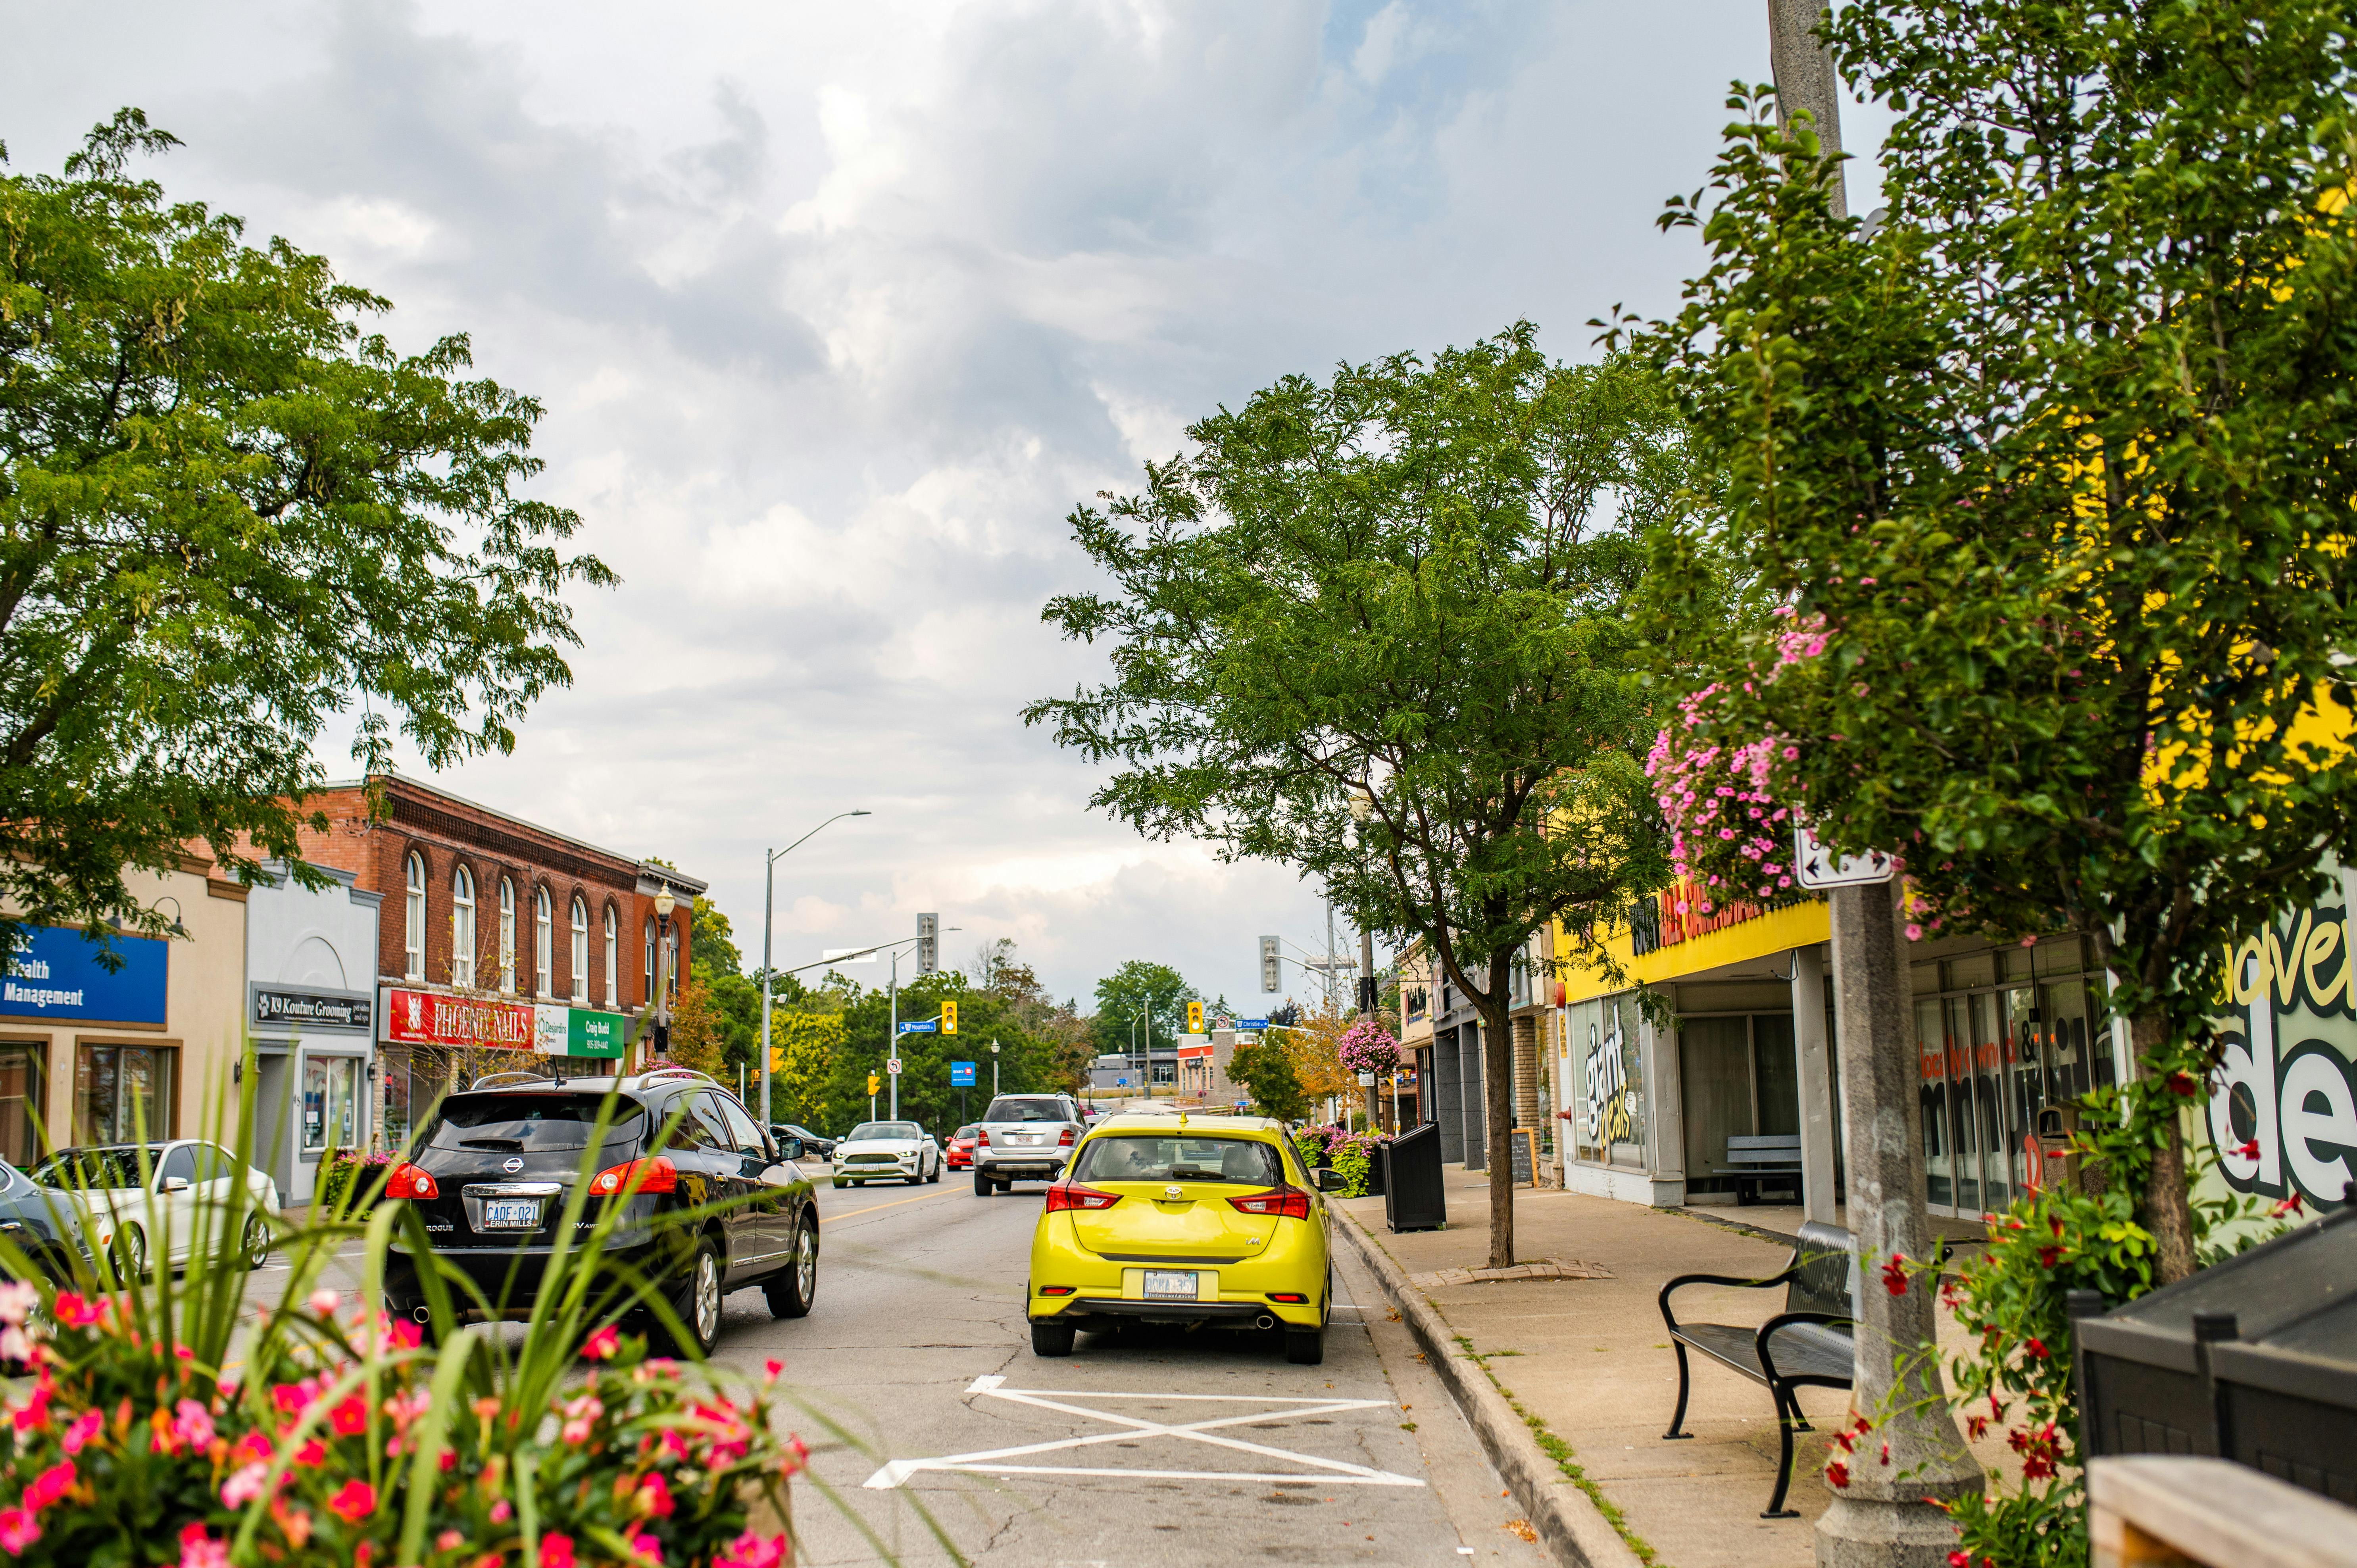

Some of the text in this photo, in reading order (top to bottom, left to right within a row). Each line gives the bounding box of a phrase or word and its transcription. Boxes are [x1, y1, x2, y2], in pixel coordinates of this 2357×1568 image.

[1660, 884, 1684, 947] ALL
[4, 982, 83, 1008] Management
[271, 997, 352, 1023] K9 Kouture Grooming
[434, 1002, 528, 1042] PHOENIX NAILS
[546, 1021, 567, 1036] Desjardins
[585, 1020, 609, 1037] Craig Budd
[1965, 1019, 2017, 1071] ownd
[1586, 1003, 1626, 1137] giant
[487, 1206, 536, 1221] CADF 021
